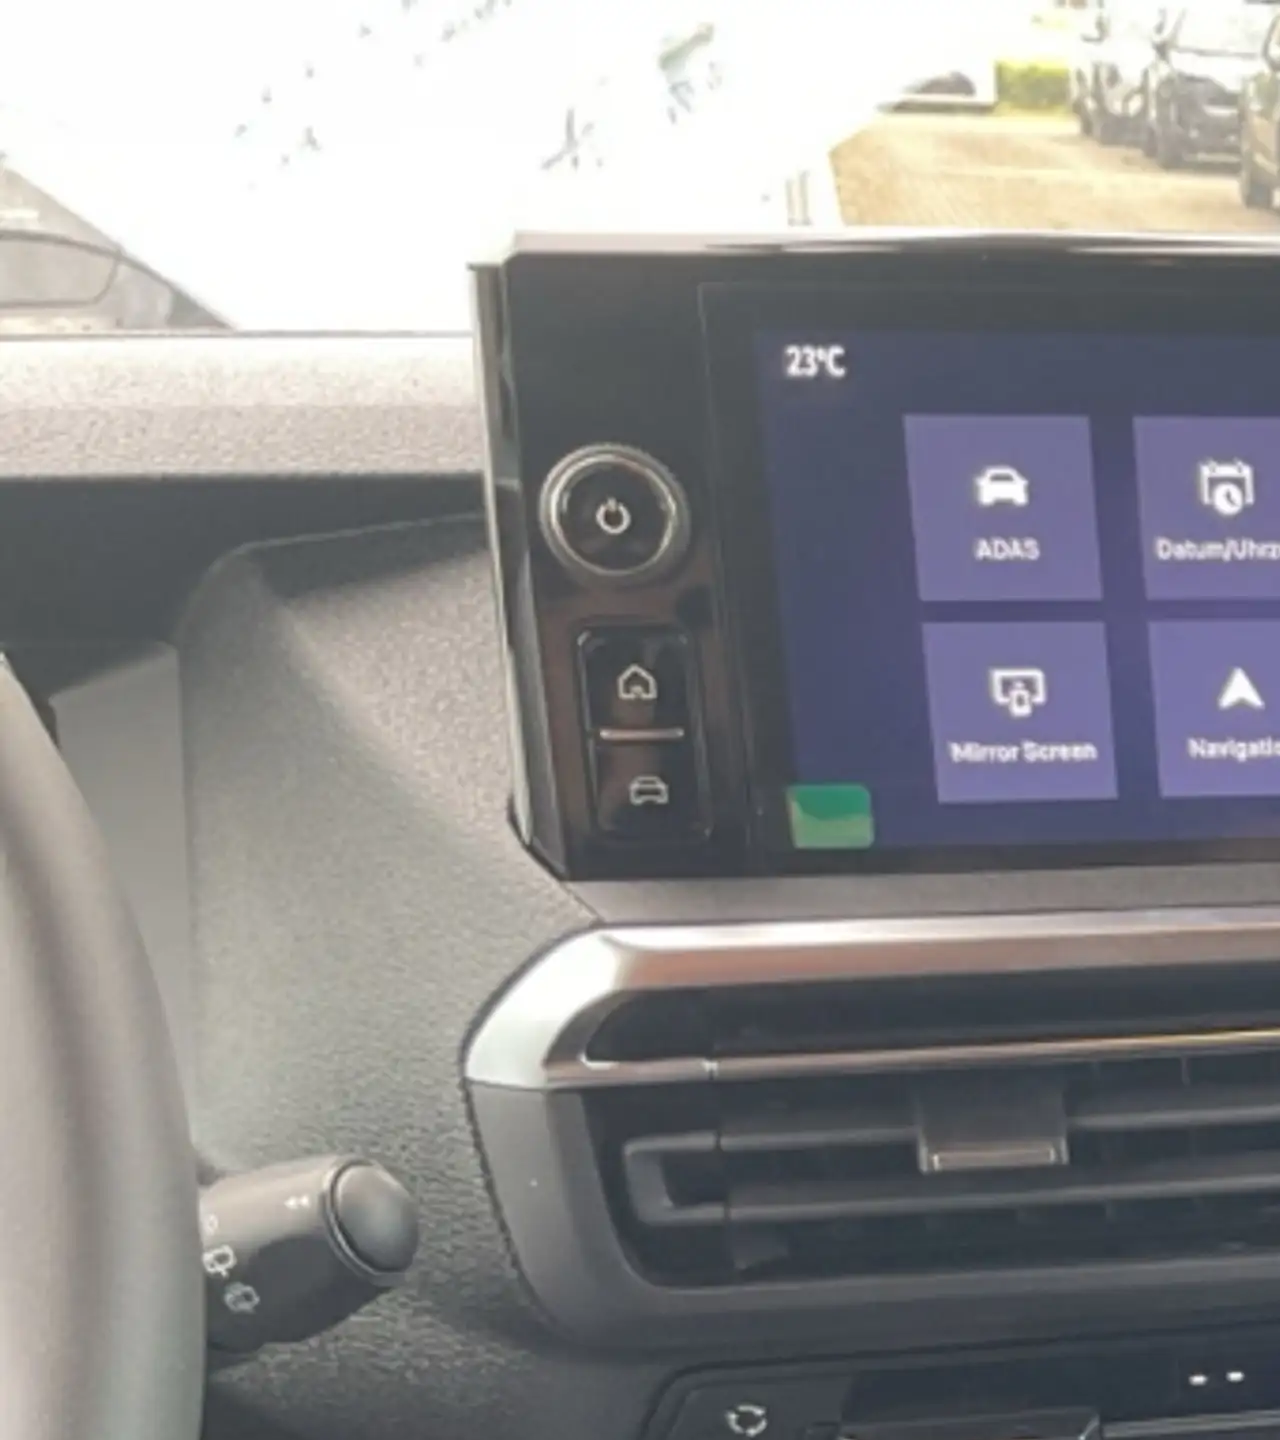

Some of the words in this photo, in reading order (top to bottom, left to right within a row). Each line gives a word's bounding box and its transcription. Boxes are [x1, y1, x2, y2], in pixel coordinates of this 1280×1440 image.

[784, 345, 846, 378] 23°C
[974, 536, 1041, 562] ADAS
[948, 741, 1019, 763] Mirror
[1023, 739, 1098, 762] Screen
